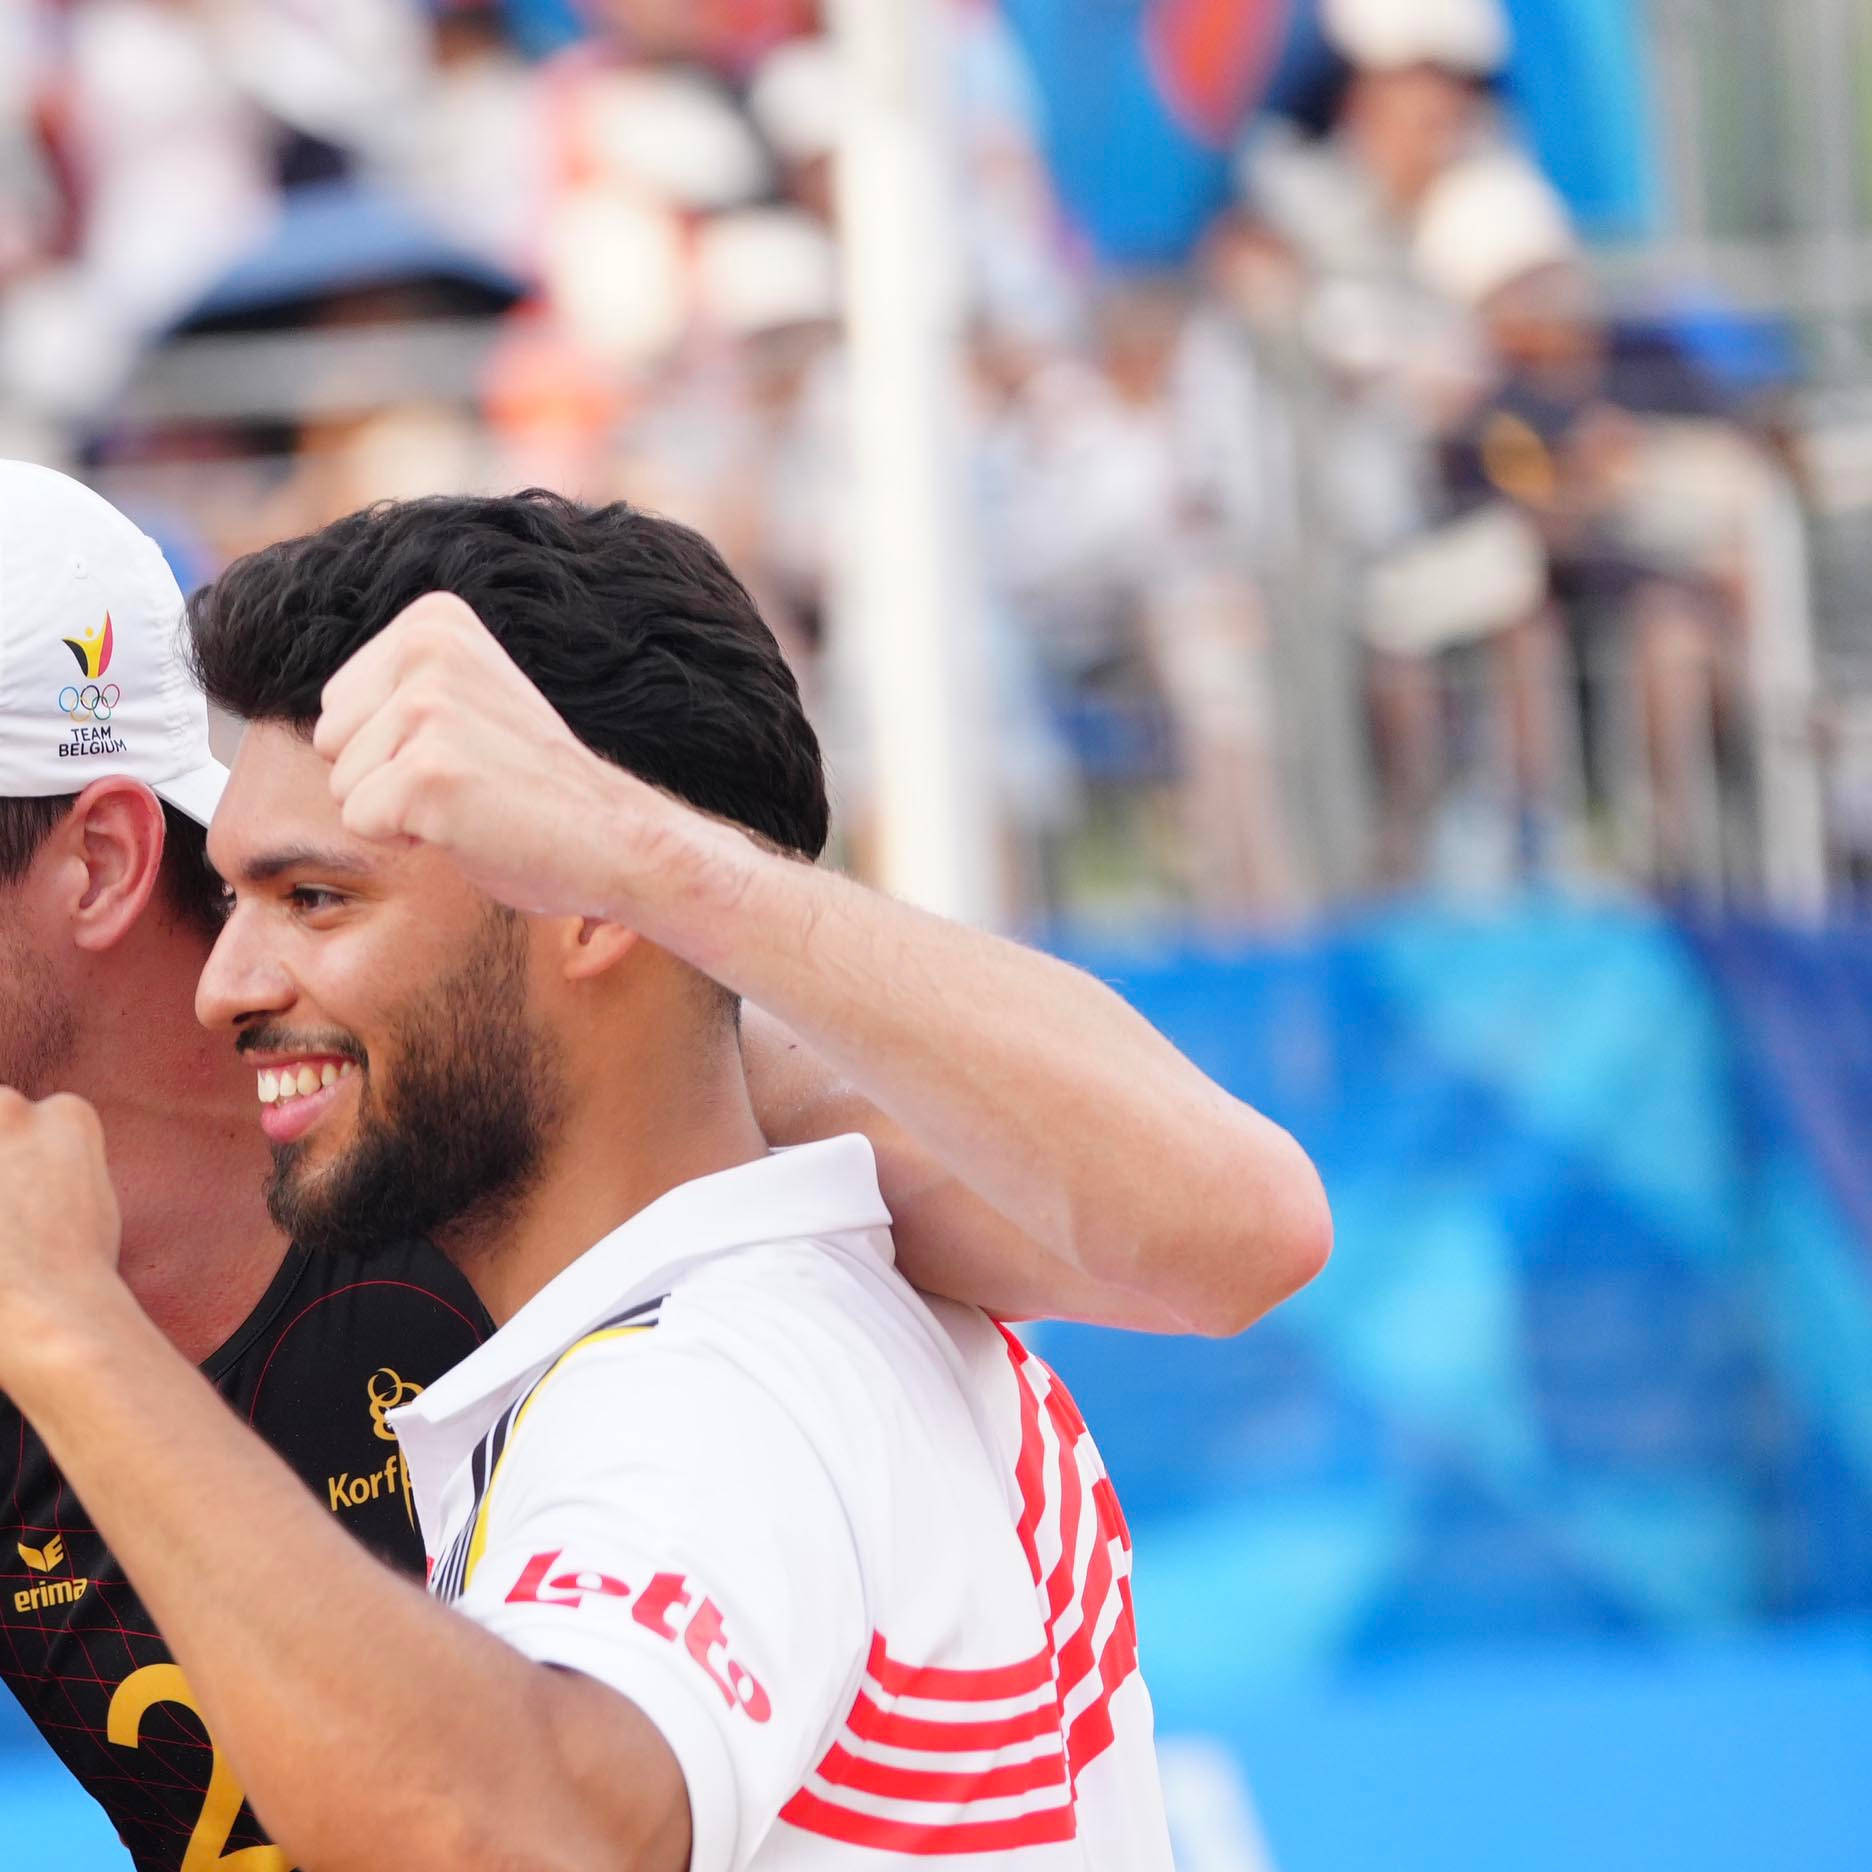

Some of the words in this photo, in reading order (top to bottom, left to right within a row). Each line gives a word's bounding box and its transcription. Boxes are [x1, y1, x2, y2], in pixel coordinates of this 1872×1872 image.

[70, 725, 112, 742] TEAM
[58, 739, 127, 757] BELGIUM
[13, 1578, 88, 1613] erima
